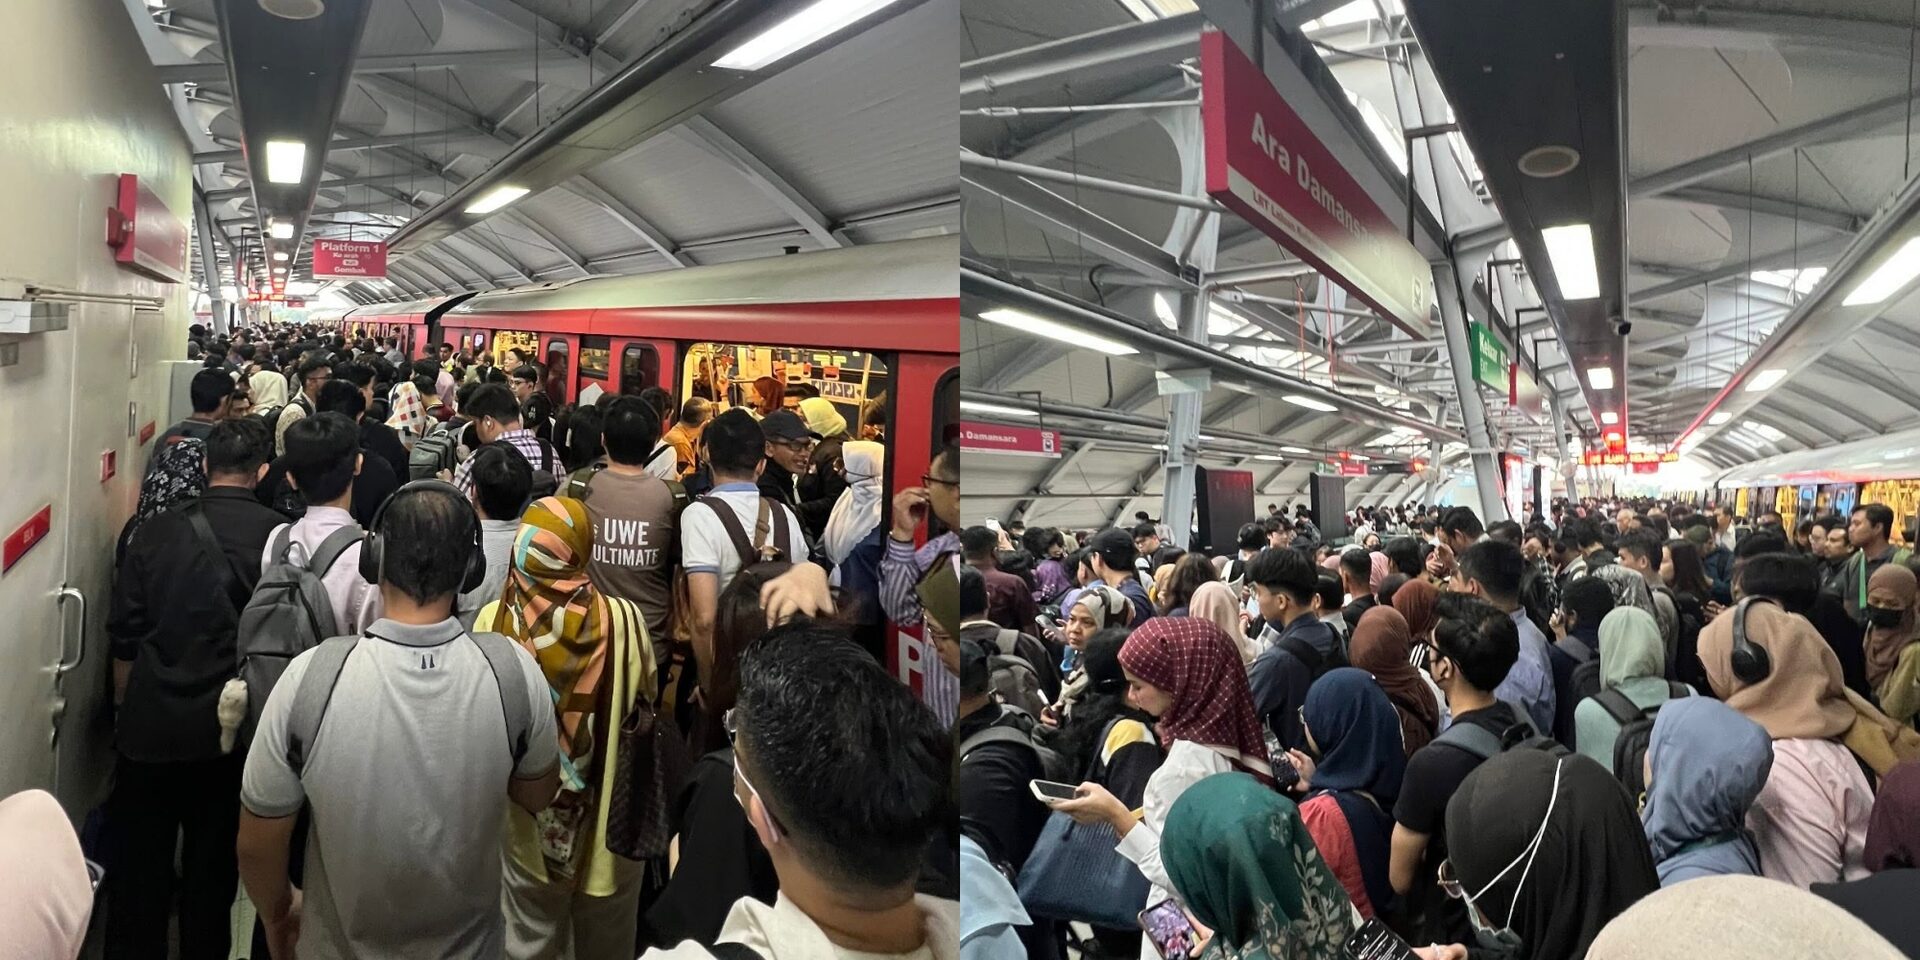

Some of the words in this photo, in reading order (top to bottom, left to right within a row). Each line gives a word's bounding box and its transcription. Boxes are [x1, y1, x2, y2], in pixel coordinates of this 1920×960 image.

[1251, 112, 1291, 176] Ara
[1297, 153, 1382, 255] Damansa
[321, 242, 370, 253] Platform
[373, 244, 379, 253] 1
[334, 266, 366, 274] Gombak
[966, 431, 1018, 443] Damansara
[604, 518, 650, 546] UWE
[593, 543, 660, 567] ULTIMATE
